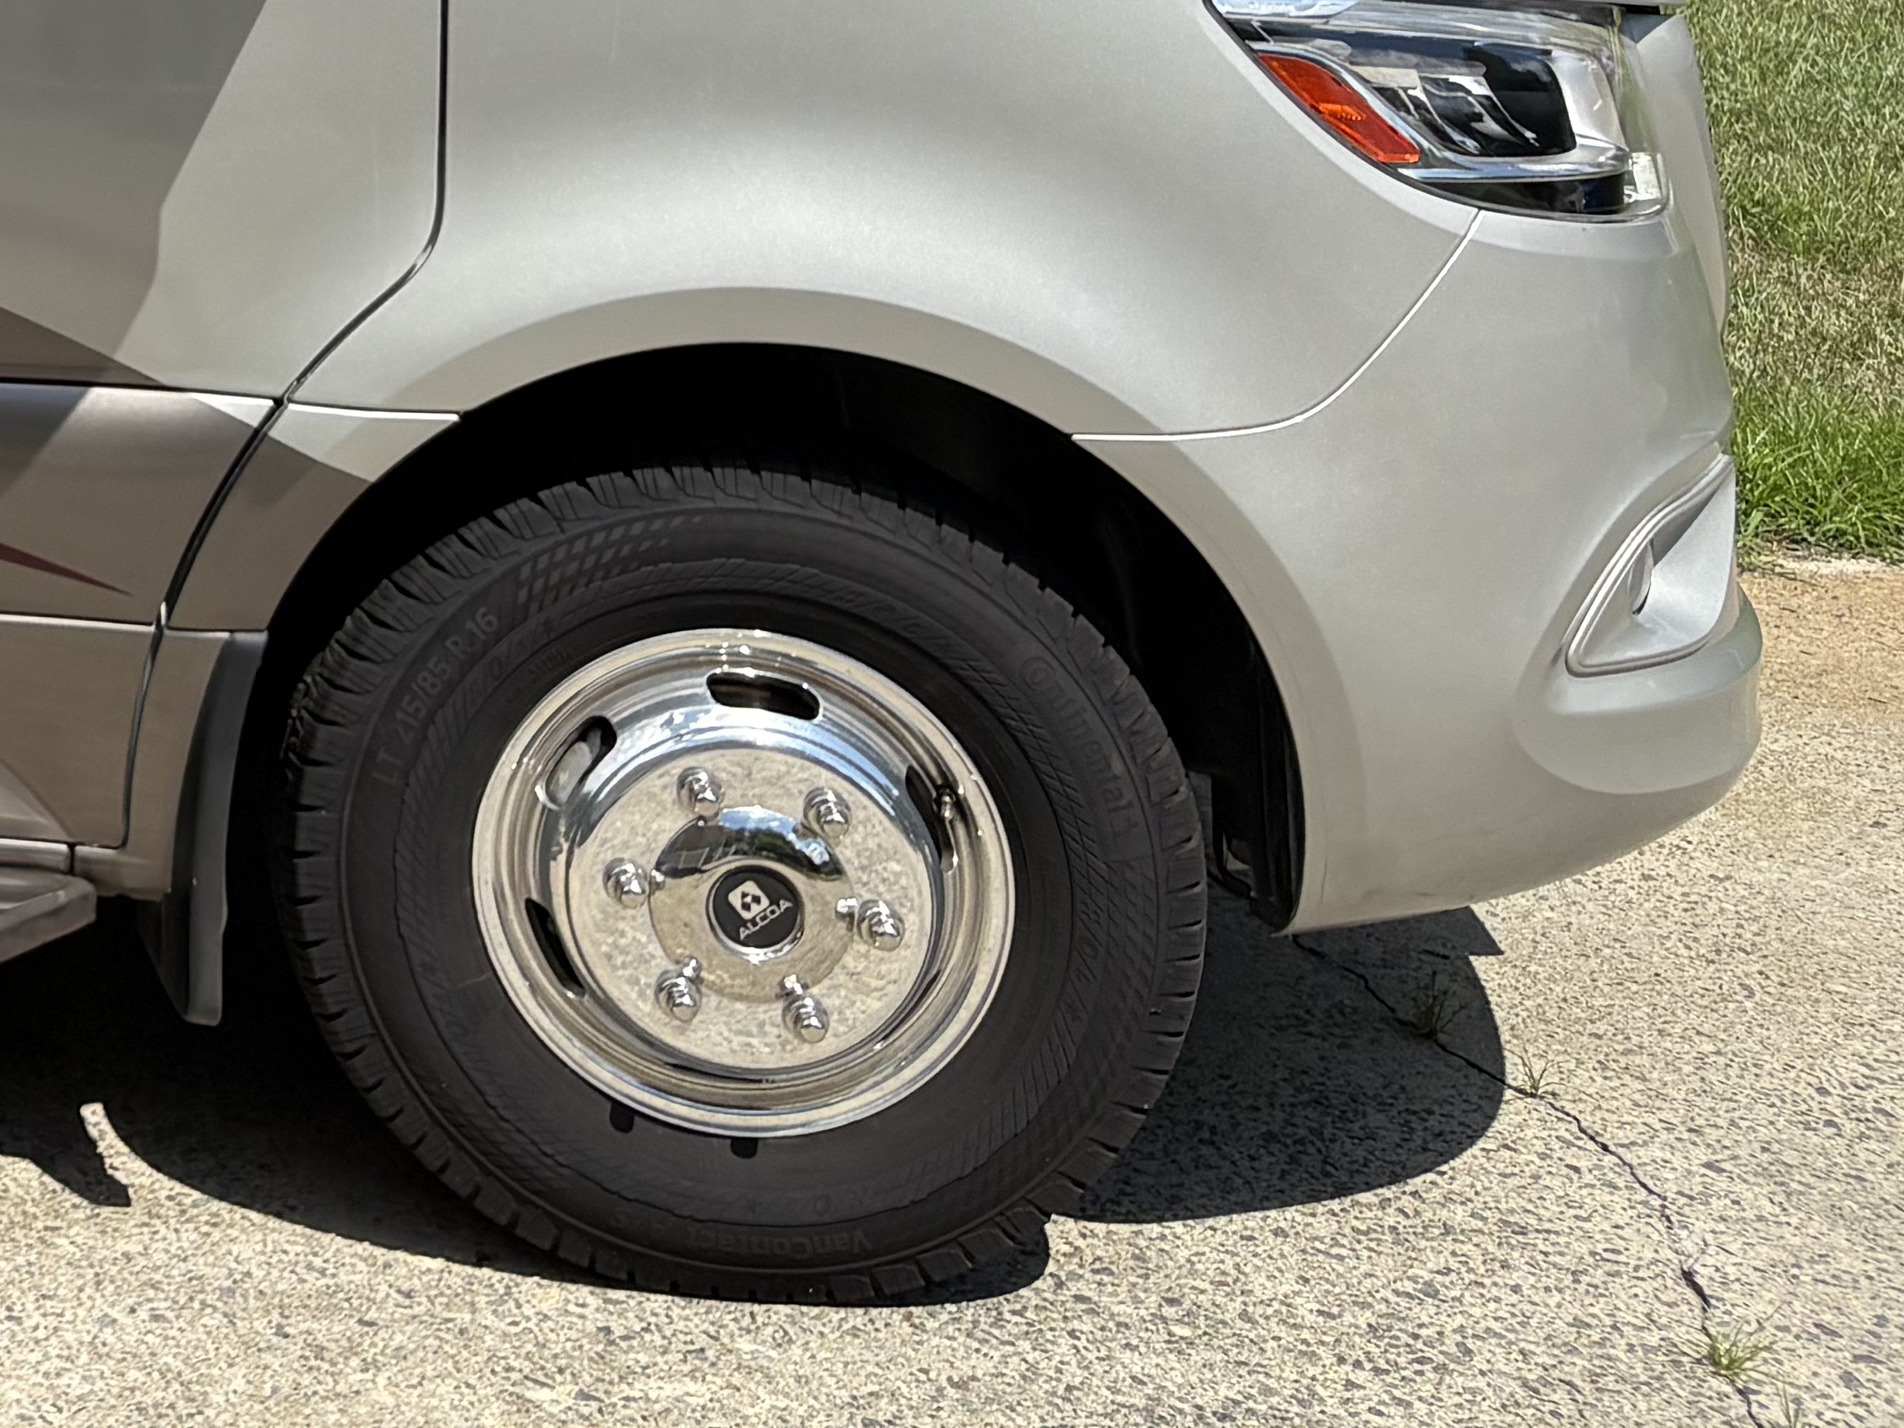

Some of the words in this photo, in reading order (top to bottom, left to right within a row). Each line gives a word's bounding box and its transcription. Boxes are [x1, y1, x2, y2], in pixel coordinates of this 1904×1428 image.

[371, 746, 402, 786] LT
[392, 655, 452, 745] 215/85
[444, 635, 477, 660] R
[465, 605, 499, 641] 16
[738, 898, 794, 941] ALCOA
[688, 1226, 874, 1260] VanContact
